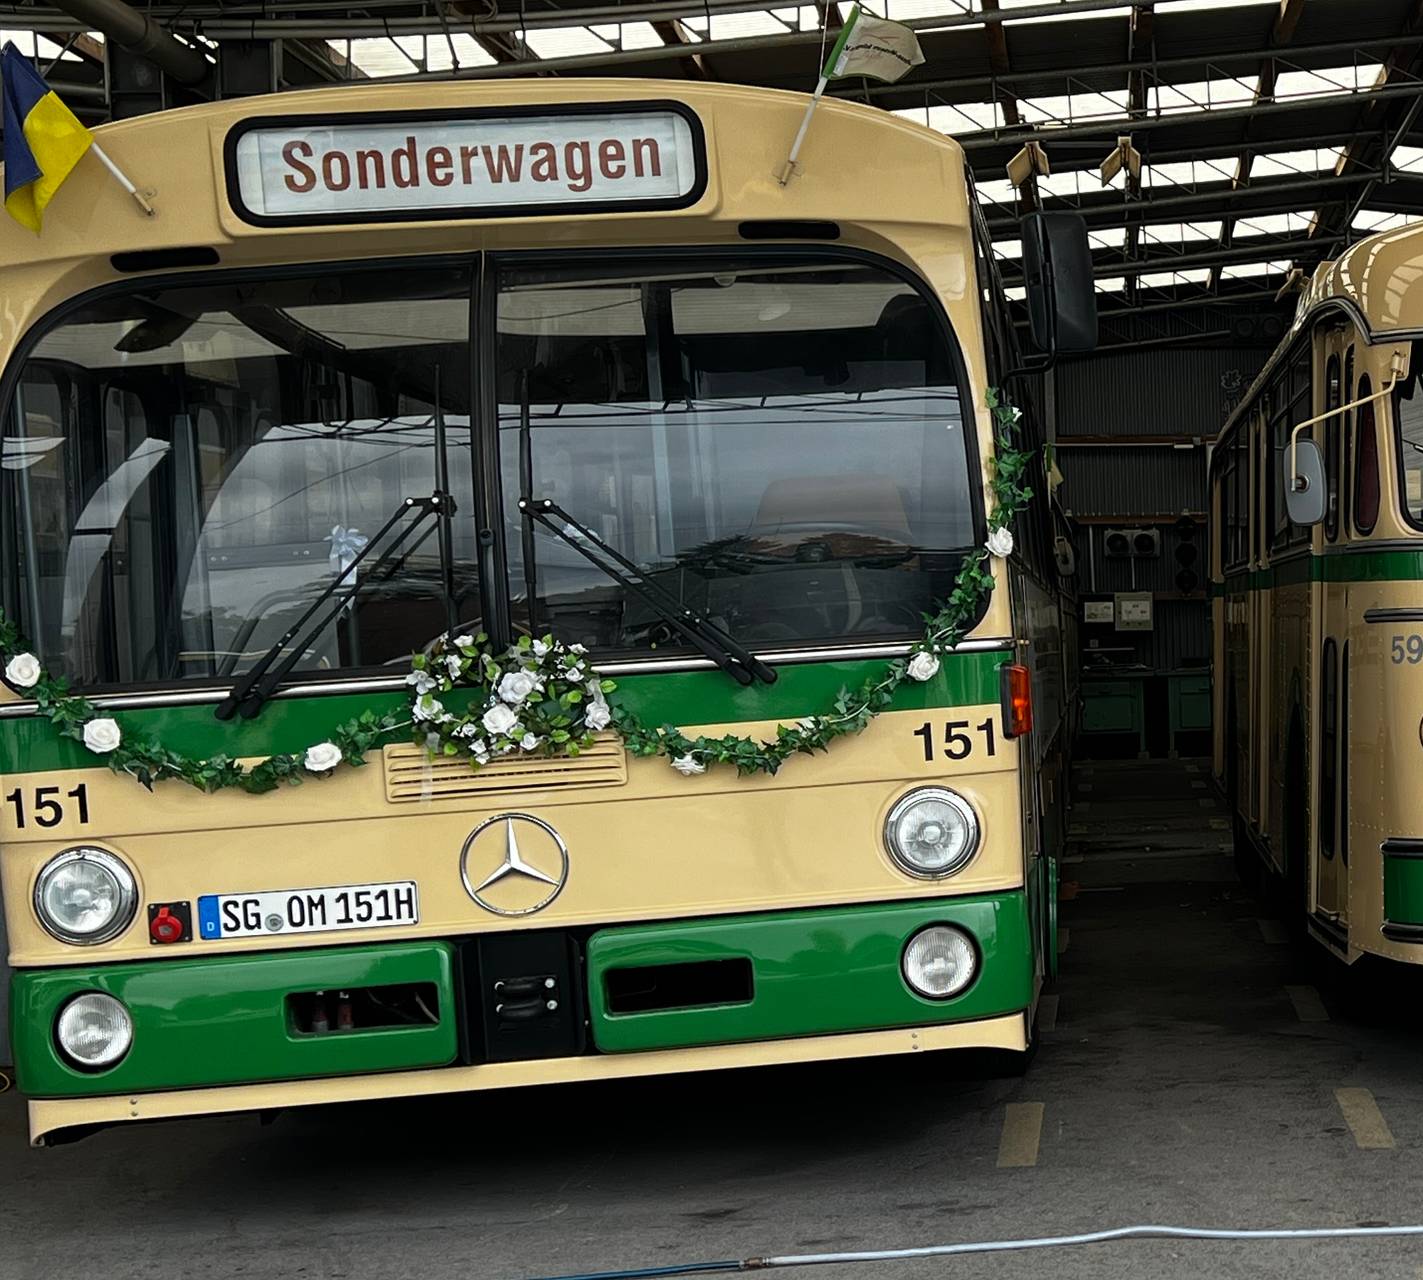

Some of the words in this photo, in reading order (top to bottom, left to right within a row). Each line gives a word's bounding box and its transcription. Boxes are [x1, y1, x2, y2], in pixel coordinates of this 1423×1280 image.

[281, 136, 662, 193] Sonderwagen
[1391, 634, 1423, 664] 59
[914, 717, 995, 761] 151
[6, 783, 89, 829] 151
[207, 922, 215, 931] D
[222, 899, 262, 932] SG
[287, 894, 327, 928] OM
[335, 887, 414, 924] 151H
